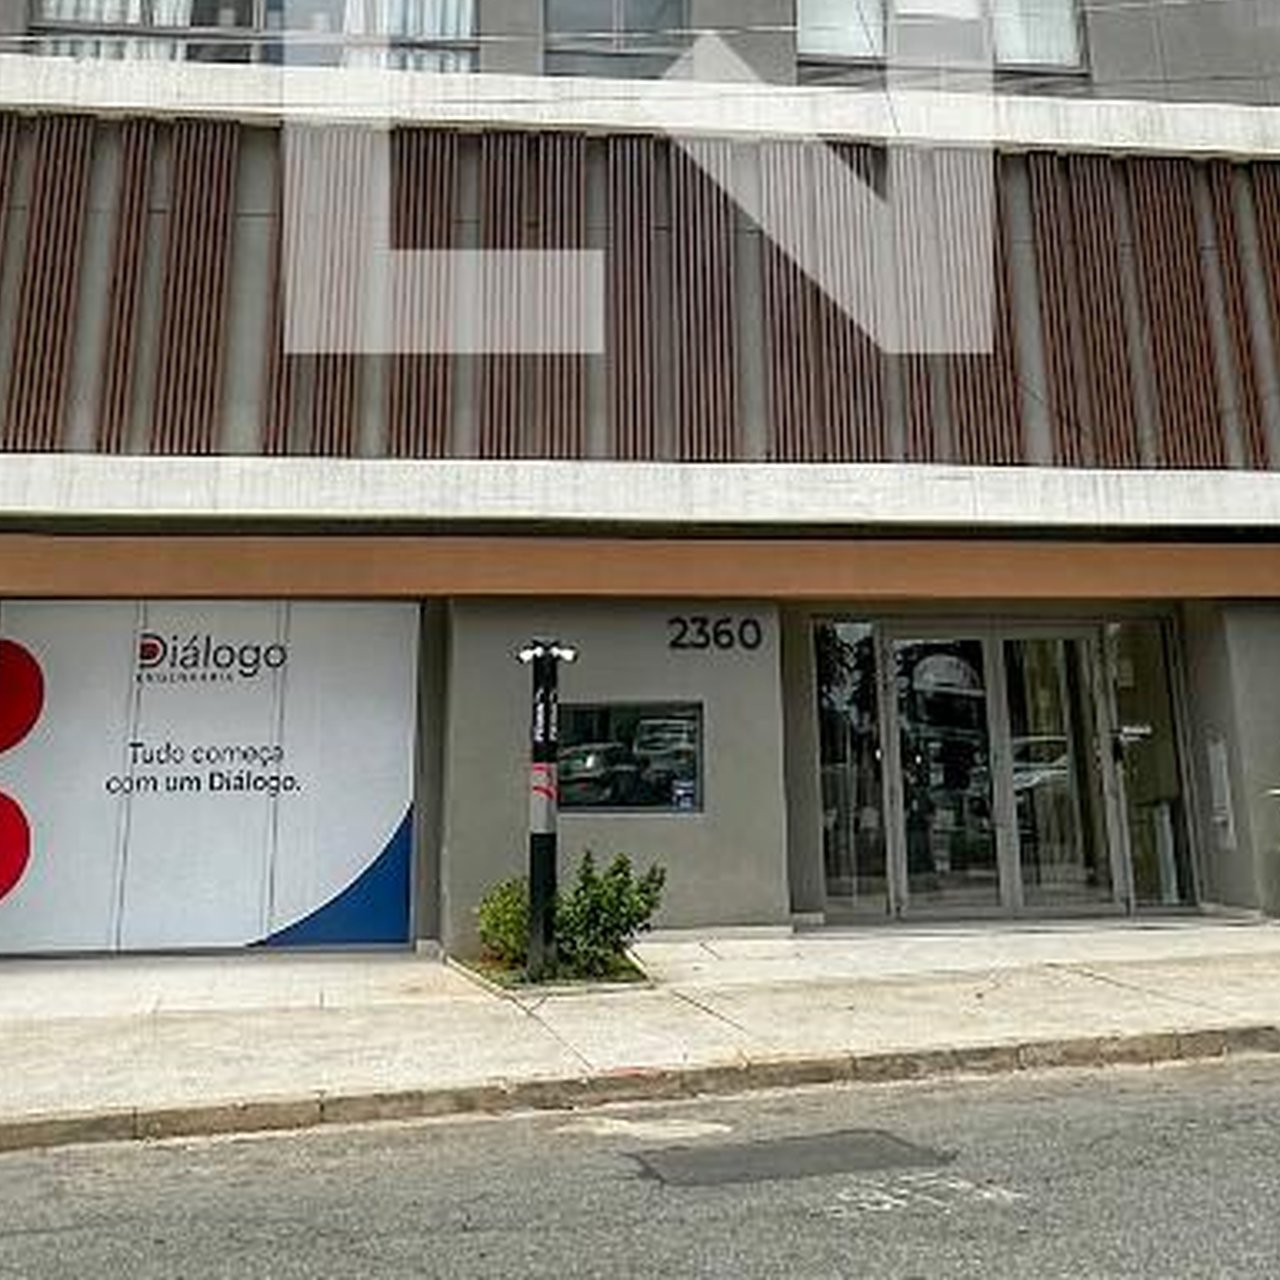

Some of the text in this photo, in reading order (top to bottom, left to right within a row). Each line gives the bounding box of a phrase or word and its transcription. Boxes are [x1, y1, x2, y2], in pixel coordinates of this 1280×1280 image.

[668, 617, 763, 651] 2360
[138, 633, 287, 677] Diálogo
[129, 742, 284, 766] Tudo começa
[106, 770, 302, 797] com um Diálogo.
